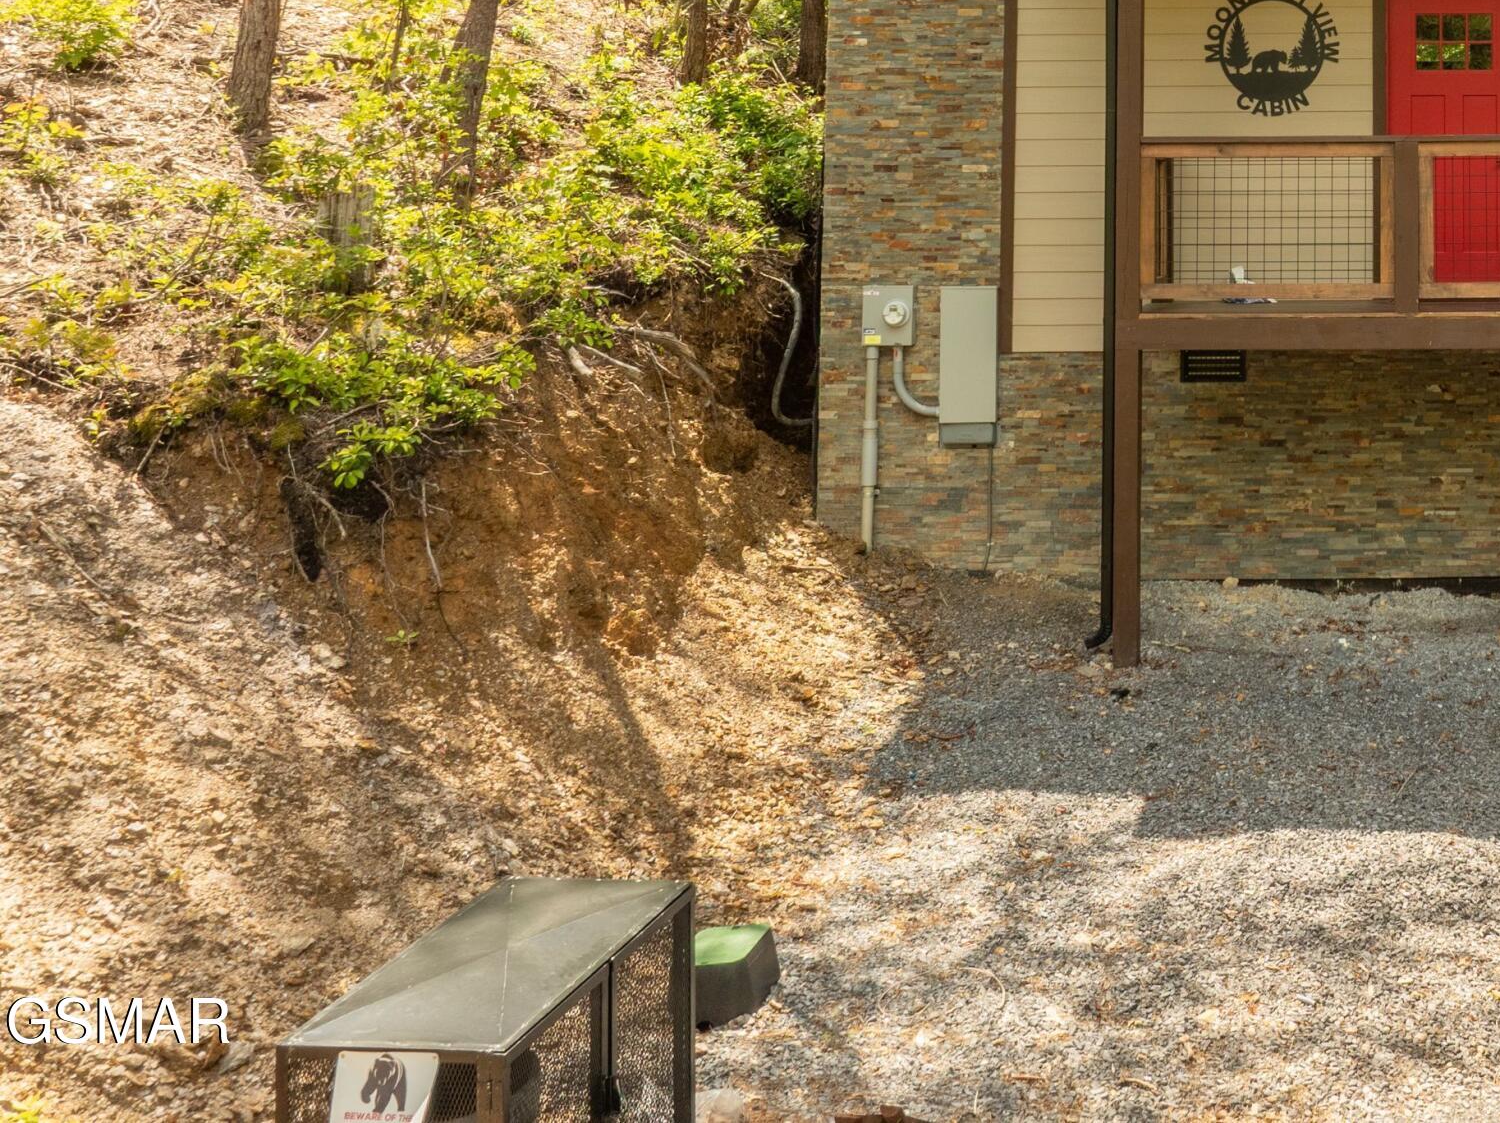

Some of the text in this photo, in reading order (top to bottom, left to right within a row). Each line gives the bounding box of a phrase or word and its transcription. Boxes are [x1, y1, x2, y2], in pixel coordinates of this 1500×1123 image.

[1312, 2, 1340, 63] VIEW
[1237, 92, 1310, 117] CABIN
[344, 1111, 382, 1121] BEWARE
[384, 1113, 397, 1122] OF
